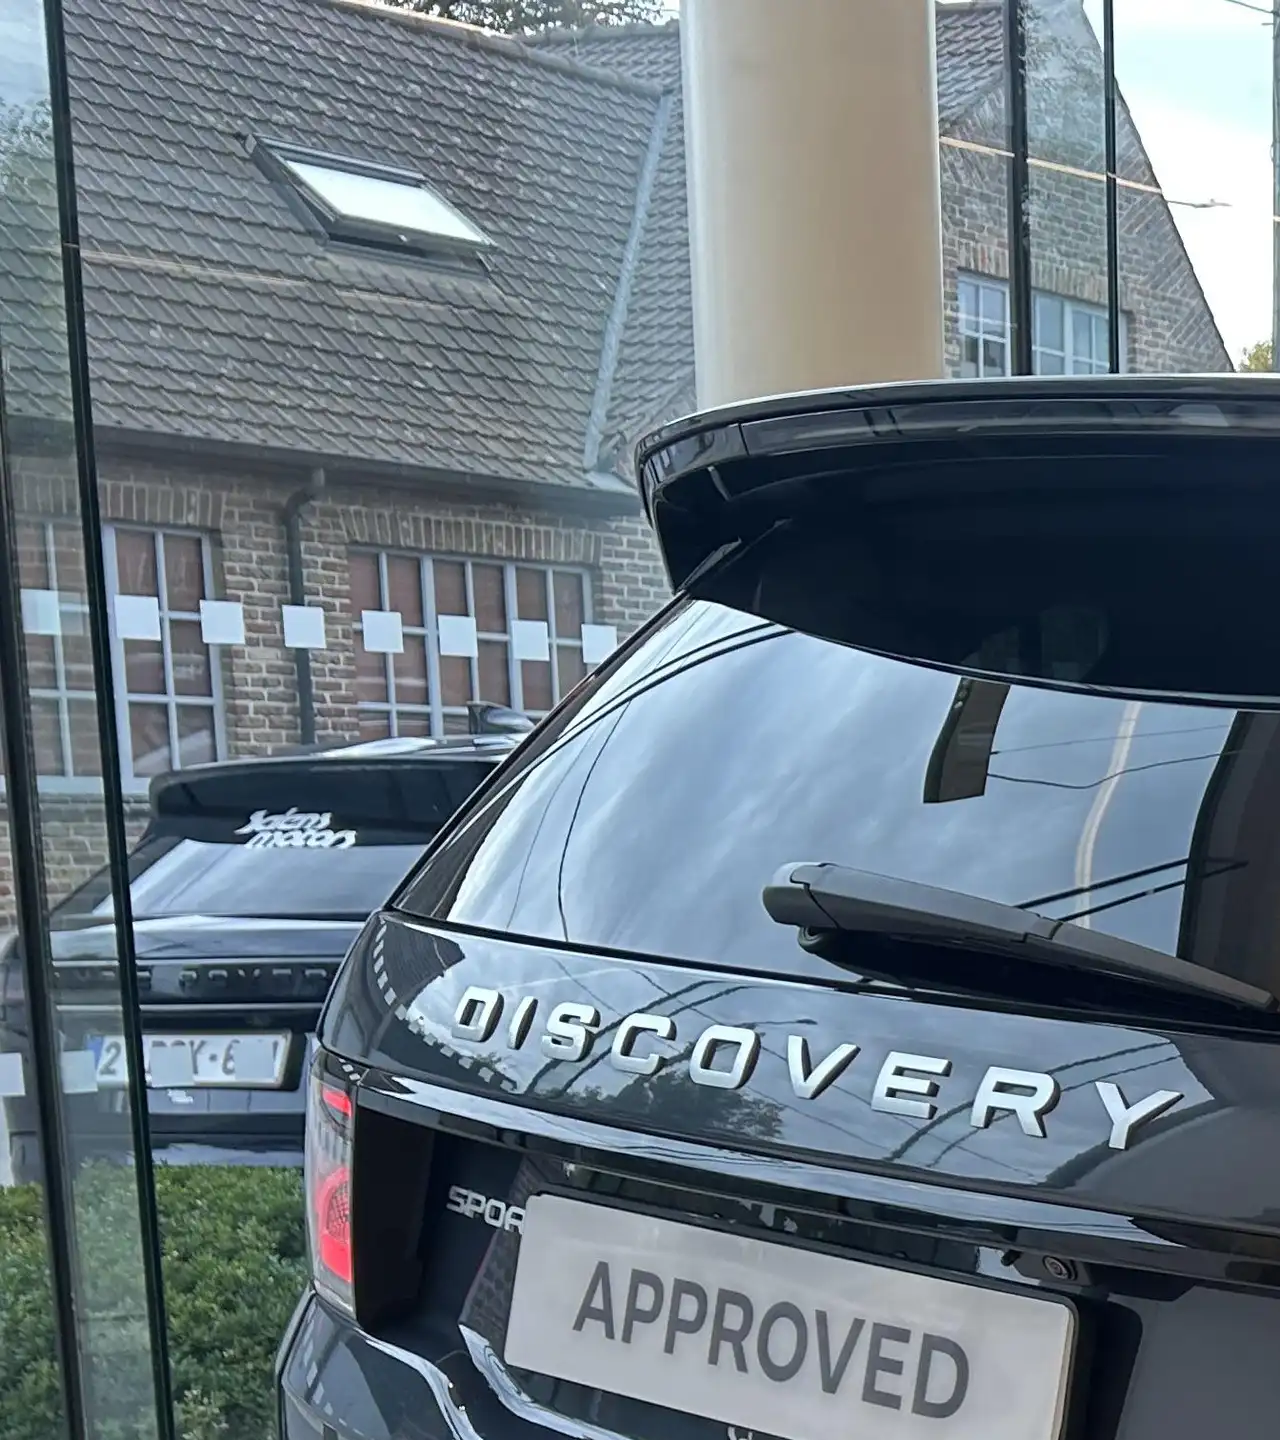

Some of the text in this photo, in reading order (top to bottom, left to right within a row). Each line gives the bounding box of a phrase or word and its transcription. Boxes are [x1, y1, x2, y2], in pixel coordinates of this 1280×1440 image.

[450, 985, 1185, 1151] DISCOVERY
[446, 1185, 526, 1235] SPOR
[573, 1260, 970, 1420] APPROVED
